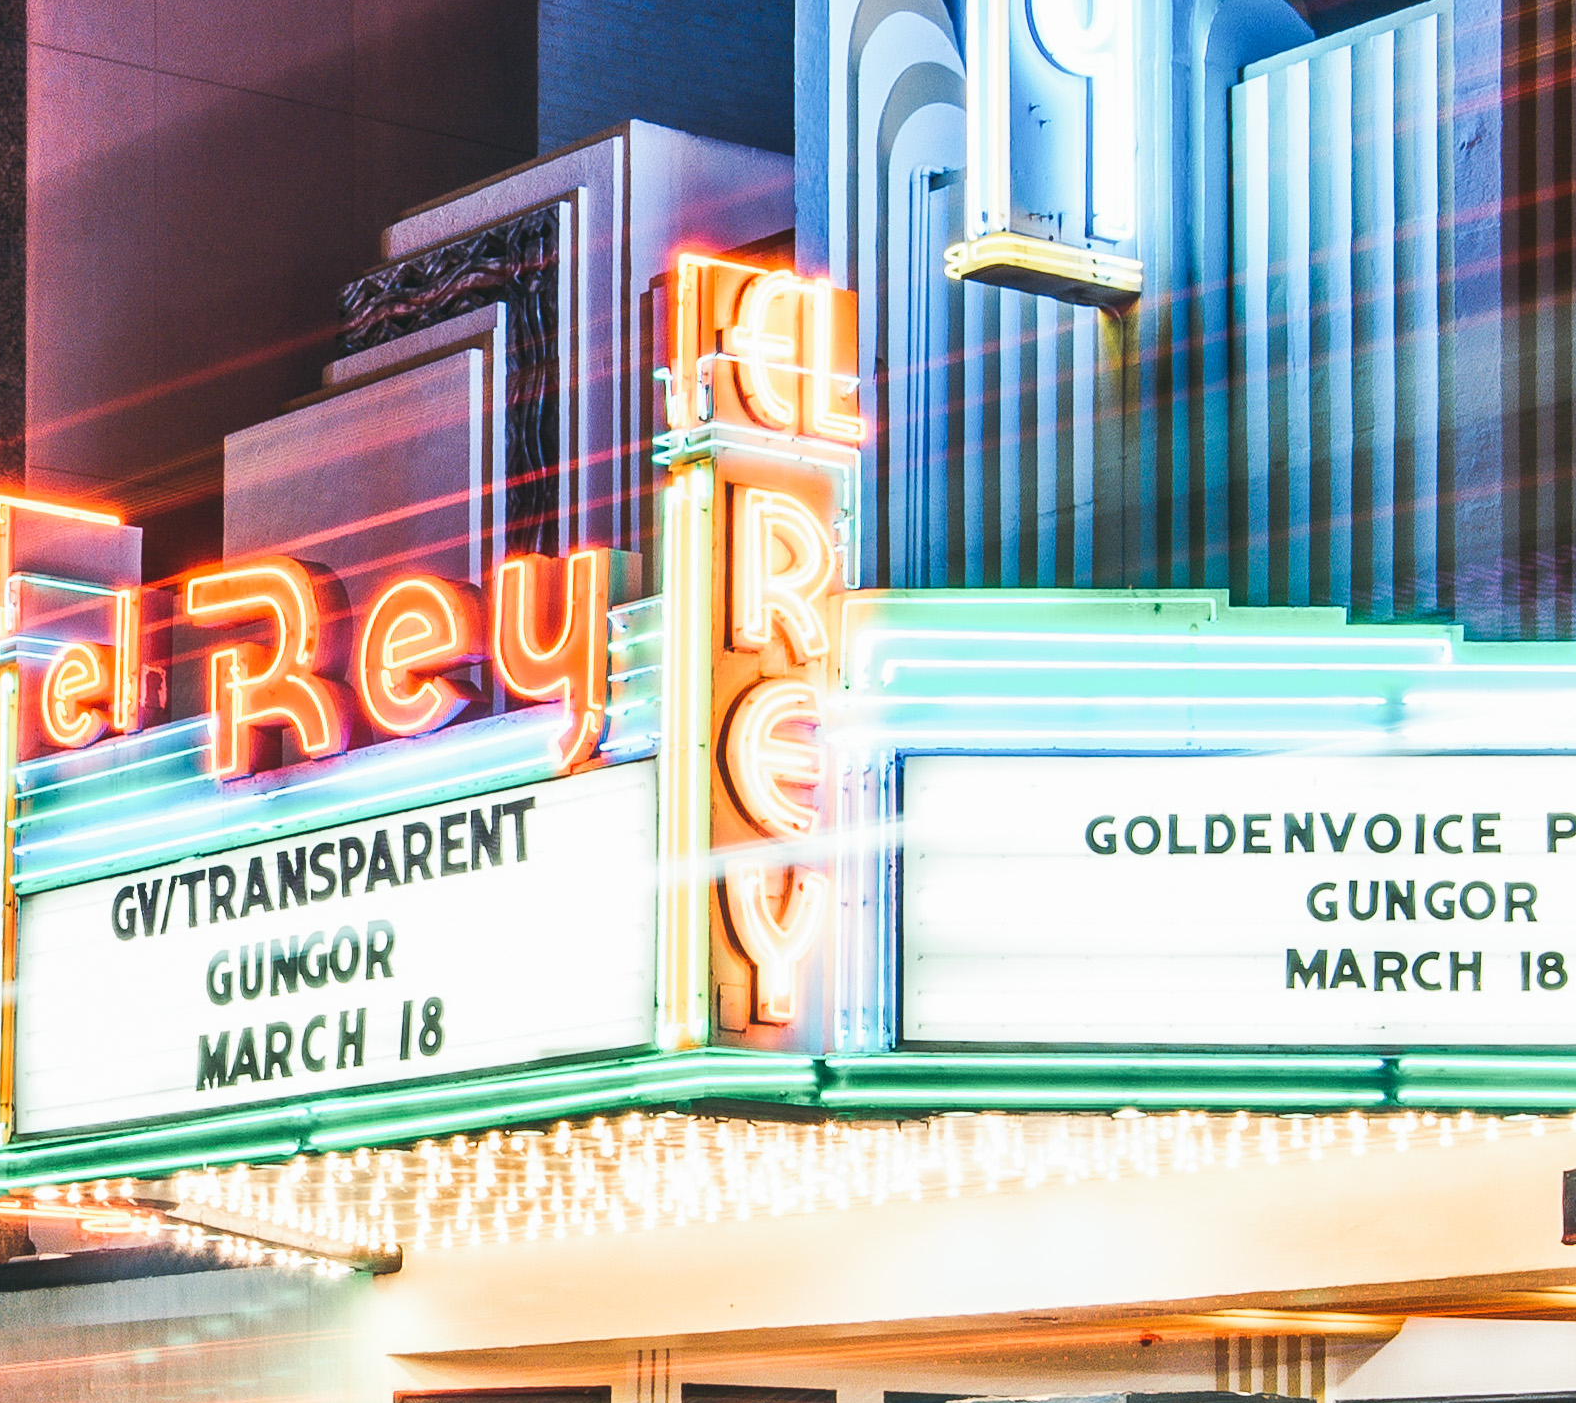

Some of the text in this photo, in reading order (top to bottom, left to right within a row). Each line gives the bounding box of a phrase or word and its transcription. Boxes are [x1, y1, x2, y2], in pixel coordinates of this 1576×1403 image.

[1083, 810, 1502, 858] GOLDENVOICE
[109, 795, 536, 943] GV/TRANSPARENT
[1304, 879, 1540, 924] GUNGOR
[205, 920, 396, 1008] GUNGOR
[1284, 949, 1569, 992] MARCH 18
[194, 995, 446, 1092] MARCH 18
